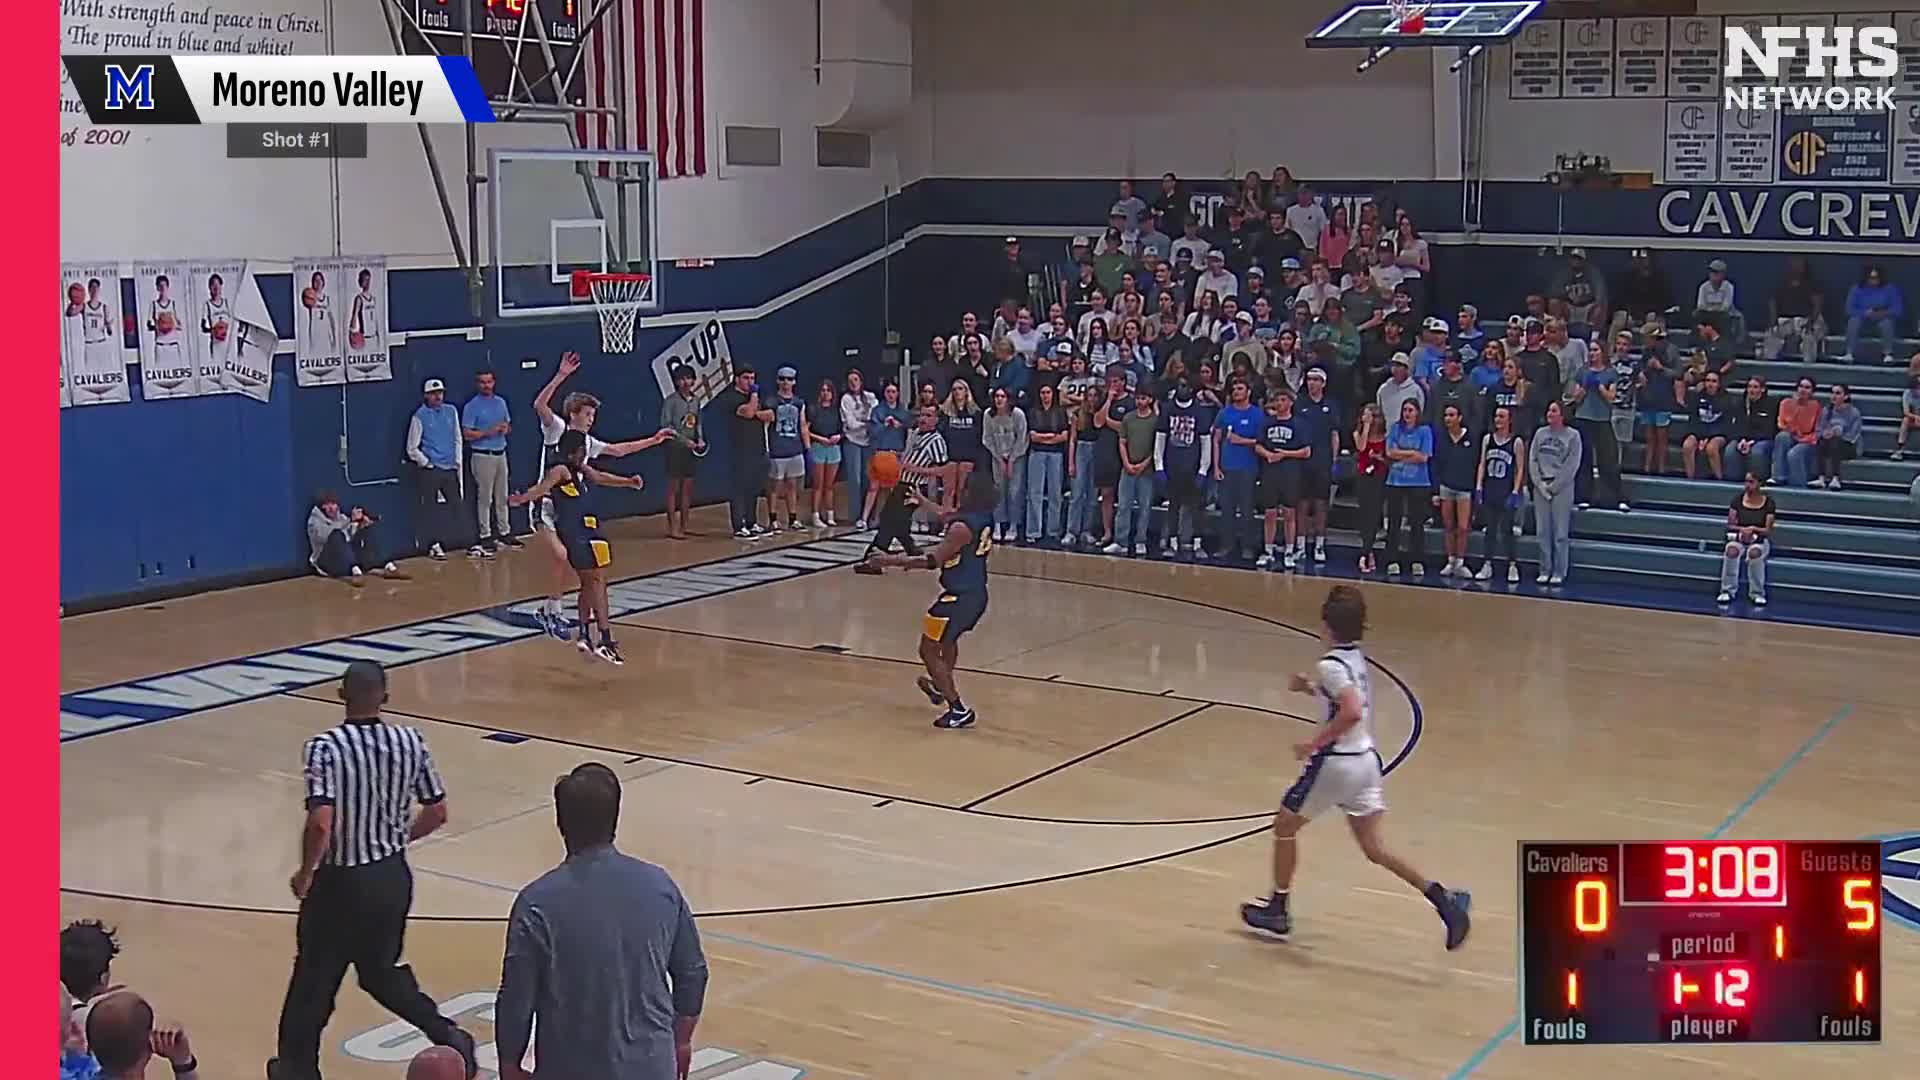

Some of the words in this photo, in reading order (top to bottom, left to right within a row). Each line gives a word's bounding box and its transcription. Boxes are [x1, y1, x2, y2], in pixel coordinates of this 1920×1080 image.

[109, 0, 175, 28] strength
[180, 6, 208, 26] and
[213, 11, 253, 32] peace
[258, 12, 272, 30] in
[277, 14, 323, 33] Christ.
[422, 8, 449, 28] fouls
[67, 25, 99, 47] The
[104, 29, 151, 53] proud
[157, 31, 172, 49] in
[178, 30, 209, 52] blue
[213, 37, 241, 54] and
[247, 38, 294, 55] white!
[552, 22, 577, 40] fouls
[84, 129, 131, 145] 2001
[1658, 190, 1769, 234] CAV
[301, 356, 342, 369] CAVALIERS
[348, 353, 387, 365] CAVALIERS
[74, 372, 123, 387] CAVALIERS
[145, 367, 193, 382] CAVALIERS
[225, 360, 268, 384] CAVALIERS
